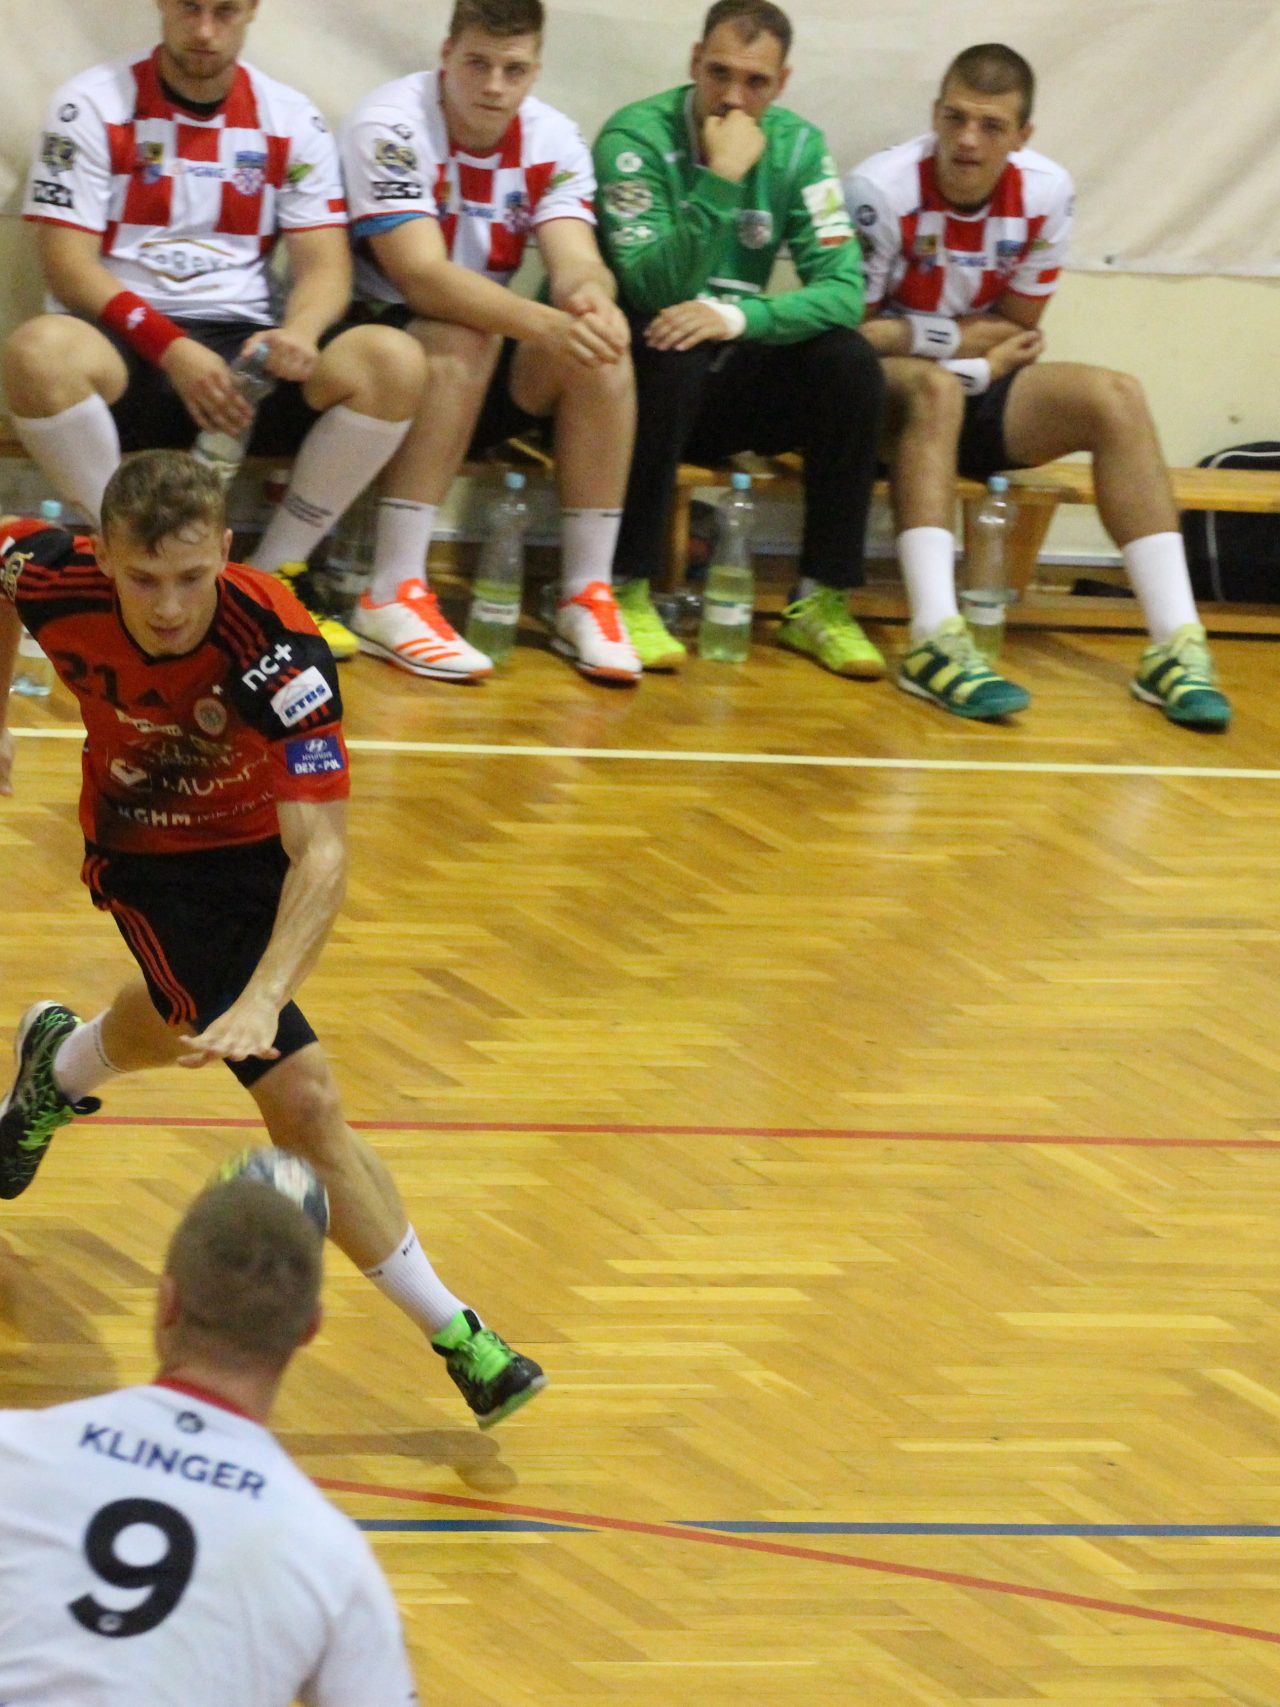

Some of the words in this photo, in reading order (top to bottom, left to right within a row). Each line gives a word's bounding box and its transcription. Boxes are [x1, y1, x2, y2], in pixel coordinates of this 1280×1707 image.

[241, 643, 293, 692] nc+
[79, 1422, 267, 1501] KLINGER
[67, 1498, 197, 1638] 9
